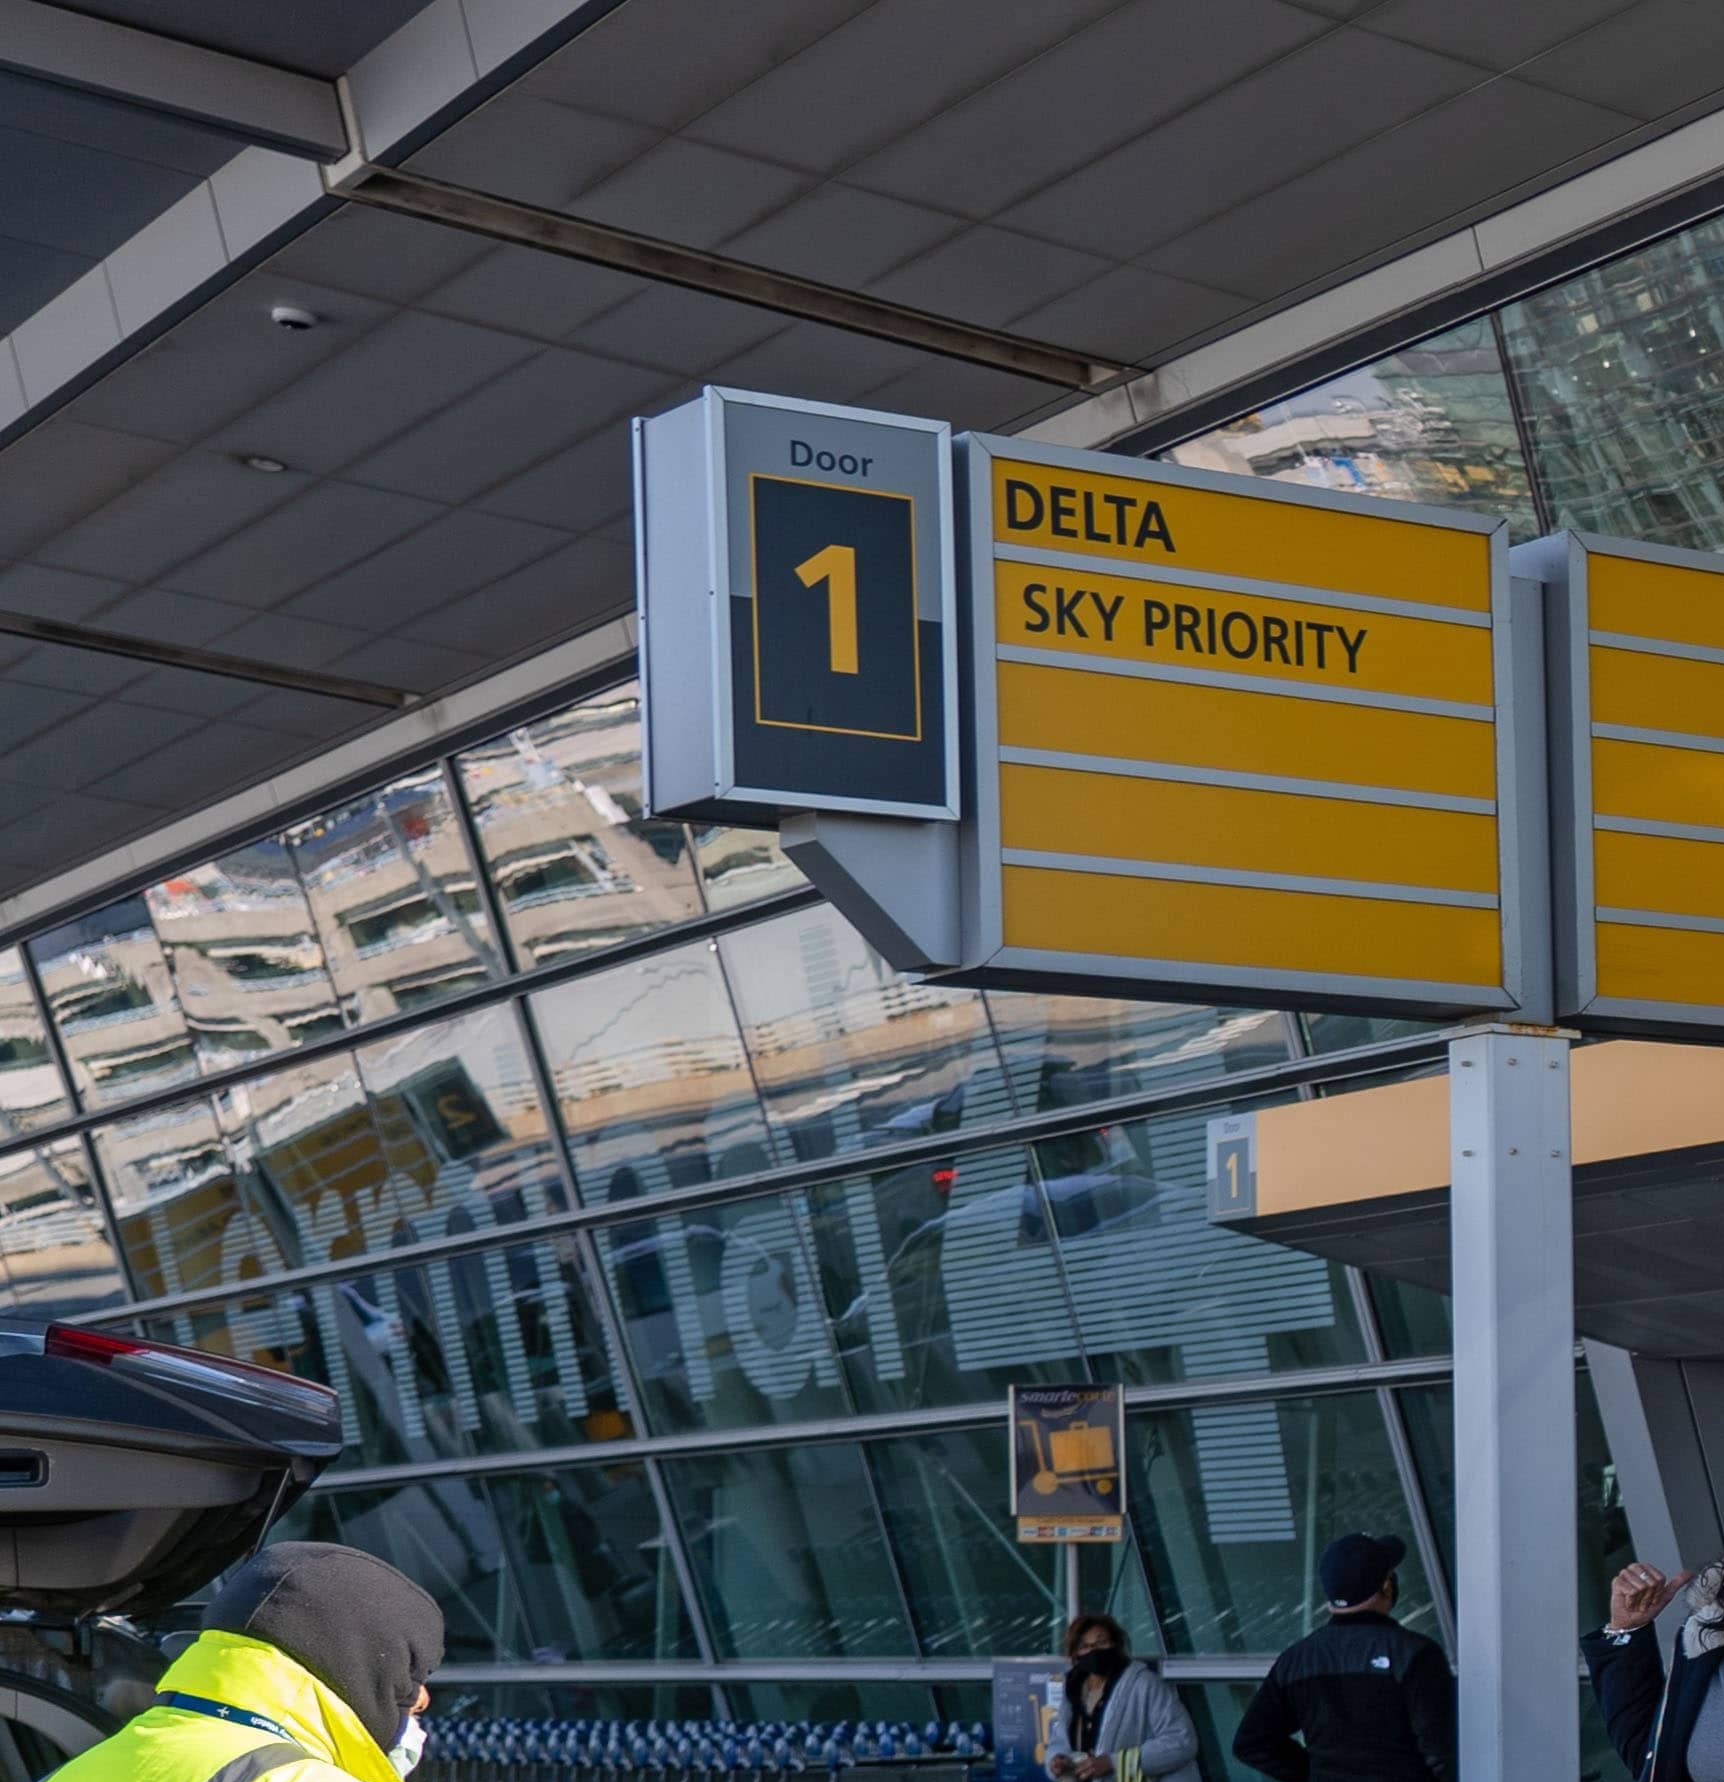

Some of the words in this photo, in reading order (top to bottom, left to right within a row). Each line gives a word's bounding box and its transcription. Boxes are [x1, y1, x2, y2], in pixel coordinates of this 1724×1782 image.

[789, 438, 874, 479] Door
[1005, 479, 1178, 554] DELTA
[794, 544, 859, 675] 1
[1022, 583, 1125, 643] SKY
[1143, 599, 1368, 675] PRIORITY
[1226, 1152, 1239, 1199] 1
